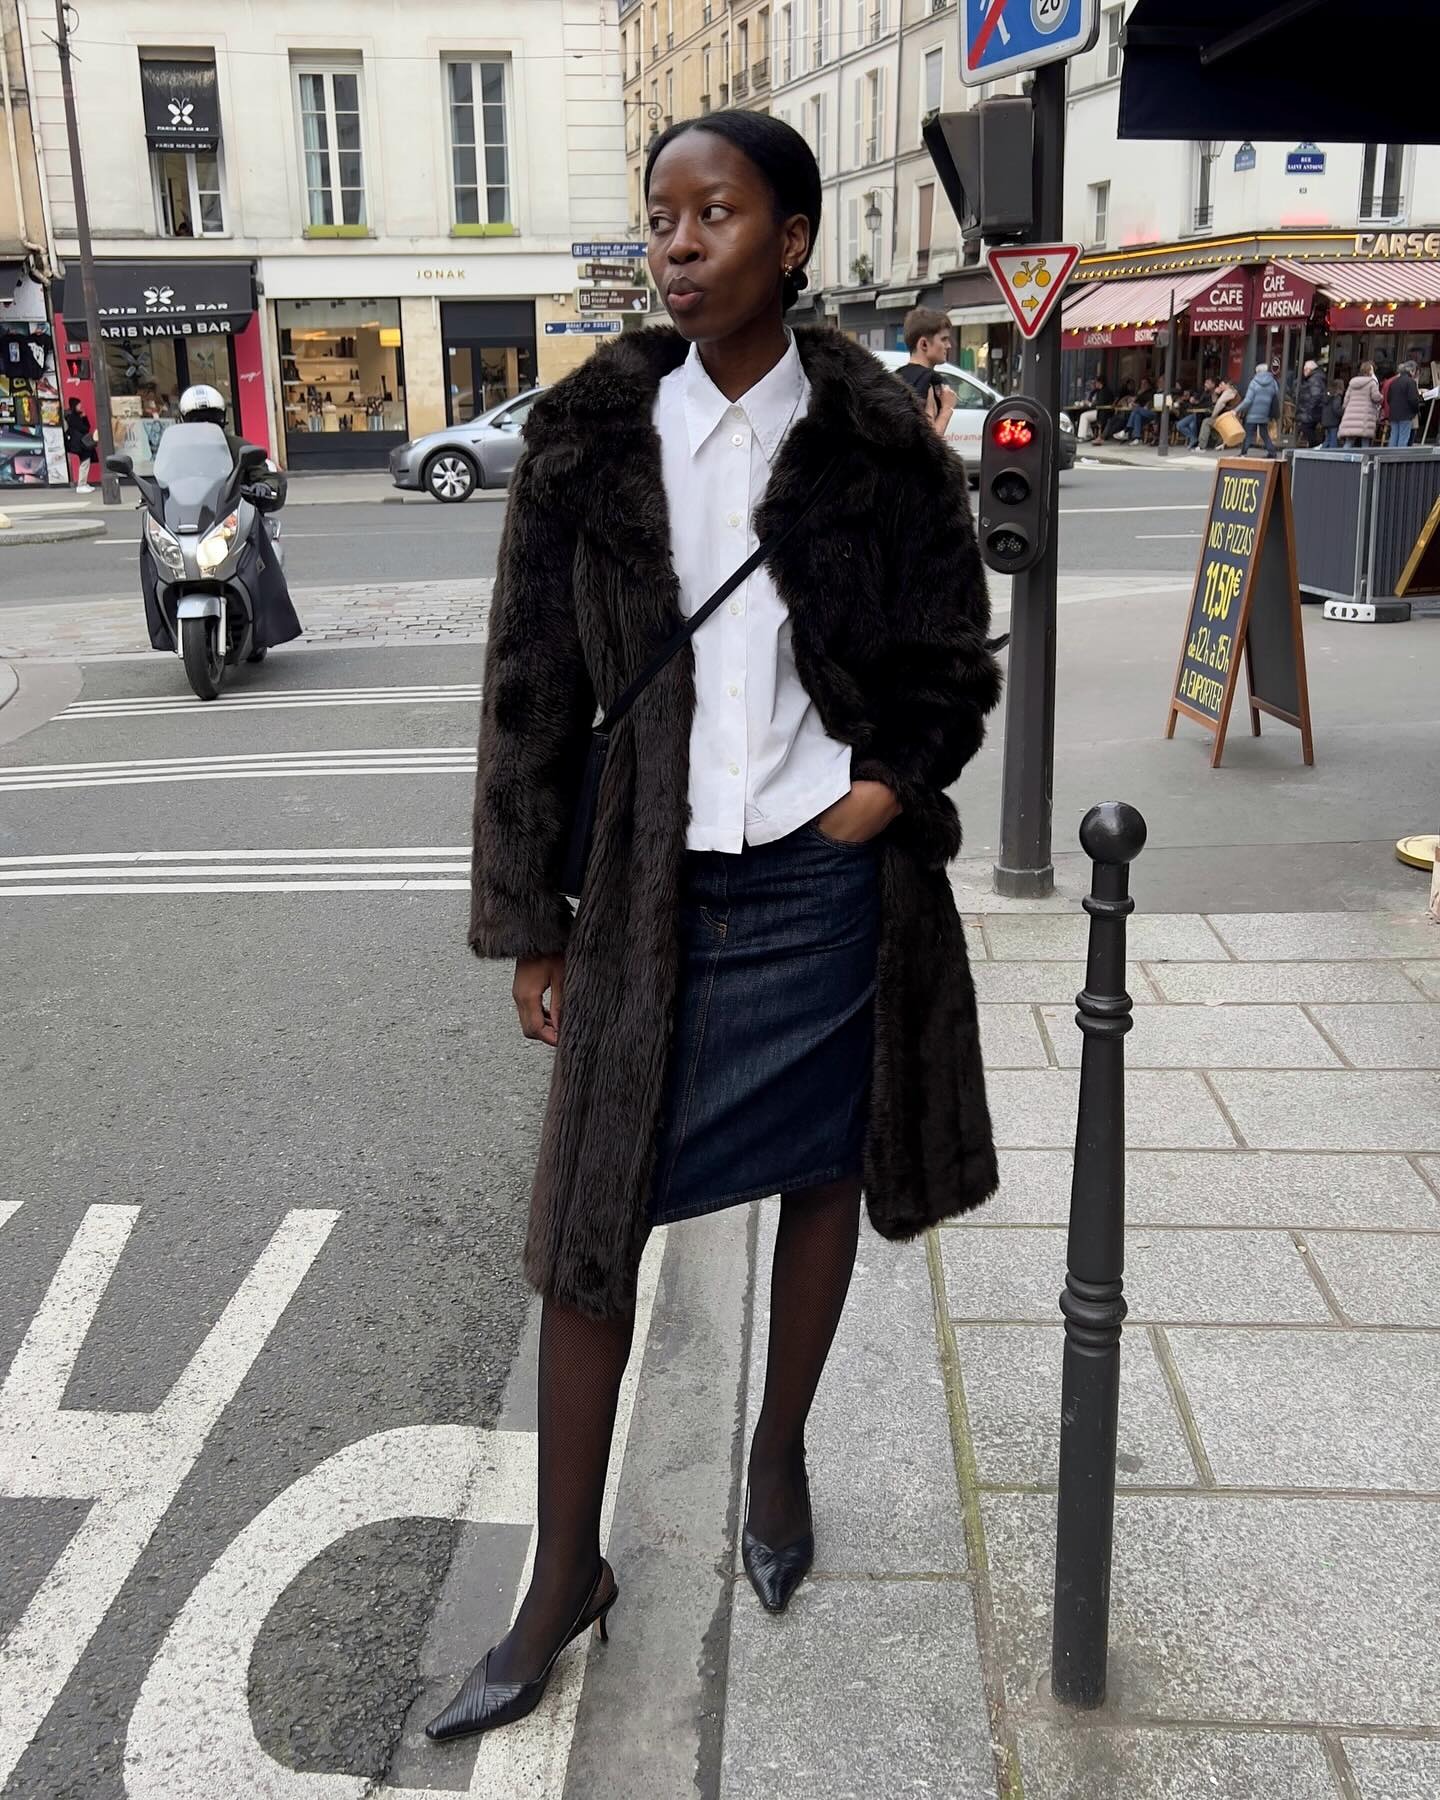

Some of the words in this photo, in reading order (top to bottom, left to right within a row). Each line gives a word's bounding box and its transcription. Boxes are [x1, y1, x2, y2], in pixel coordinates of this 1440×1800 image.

[1039, 0, 1061, 15] 20
[1263, 275, 1286, 292] CAFE
[1209, 289, 1243, 305] CAFE
[98, 307, 137, 315] ARIS
[146, 304, 187, 313] HAIR
[195, 303, 228, 311] BAR
[1260, 298, 1305, 318] L'ARSENAL
[1194, 319, 1244, 332] L'ARSENAL
[1366, 314, 1395, 328] CAFE
[100, 325, 138, 339] ARIS
[143, 323, 192, 336] NAILS
[197, 321, 231, 334] BAR
[1221, 476, 1259, 513] TOUTES
[1208, 522, 1225, 550] NOS
[1225, 525, 1255, 556] PIZZAS
[1186, 671, 1225, 713] EMPORTER
